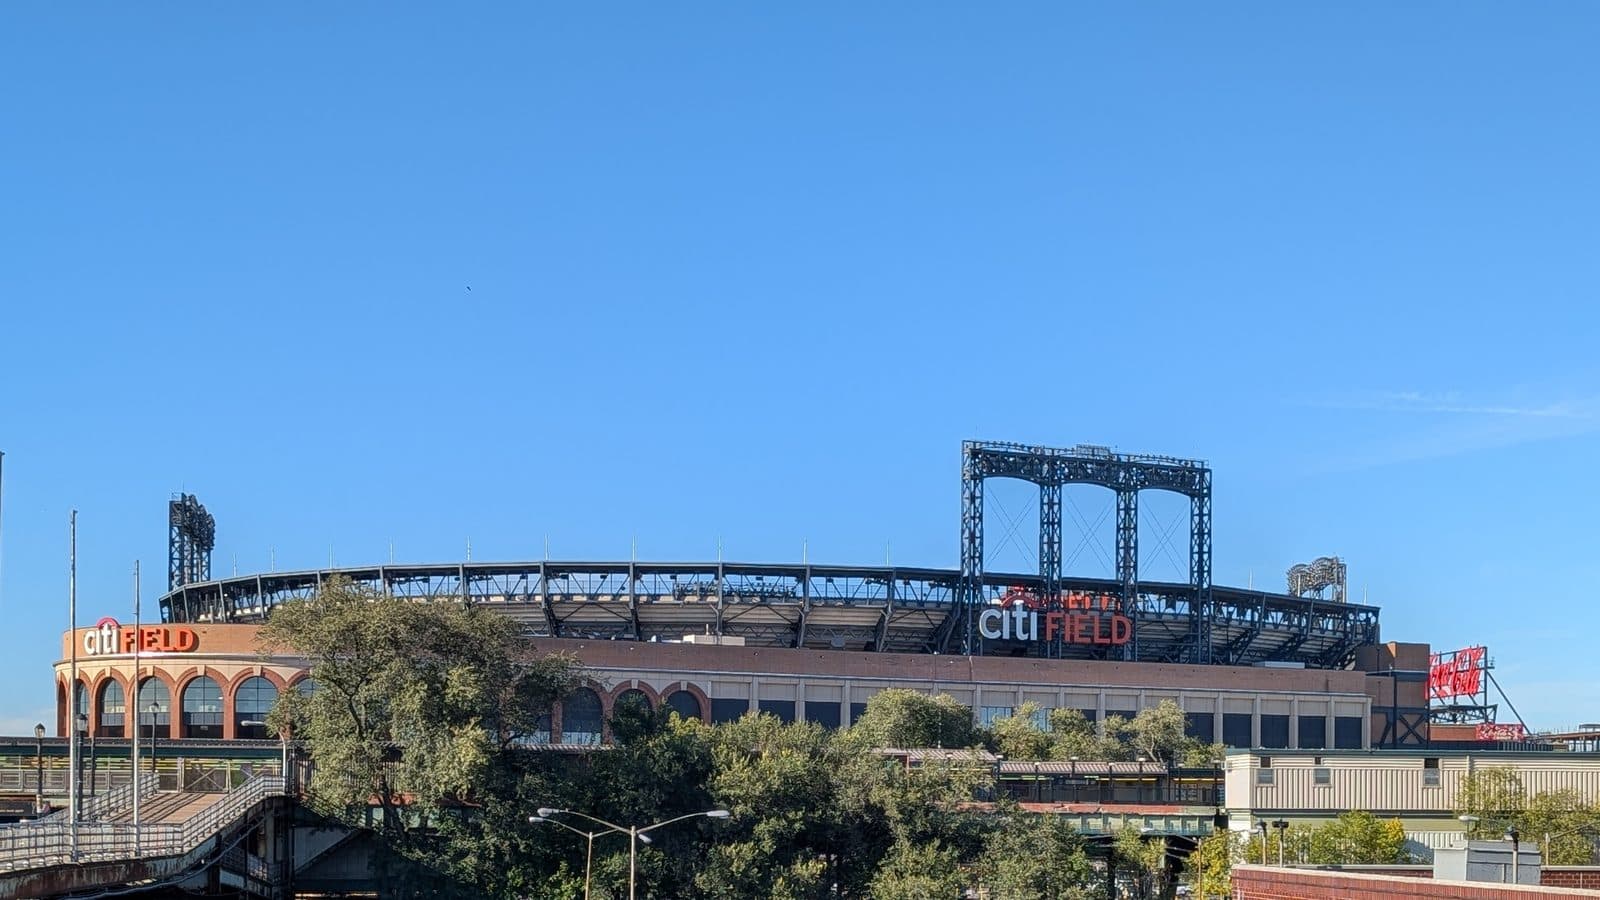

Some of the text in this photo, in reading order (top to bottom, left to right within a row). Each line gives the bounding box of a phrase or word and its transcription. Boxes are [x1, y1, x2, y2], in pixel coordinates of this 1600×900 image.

[84, 620, 119, 655] citi
[979, 599, 1037, 641] citi
[1045, 612, 1133, 644] FIELD
